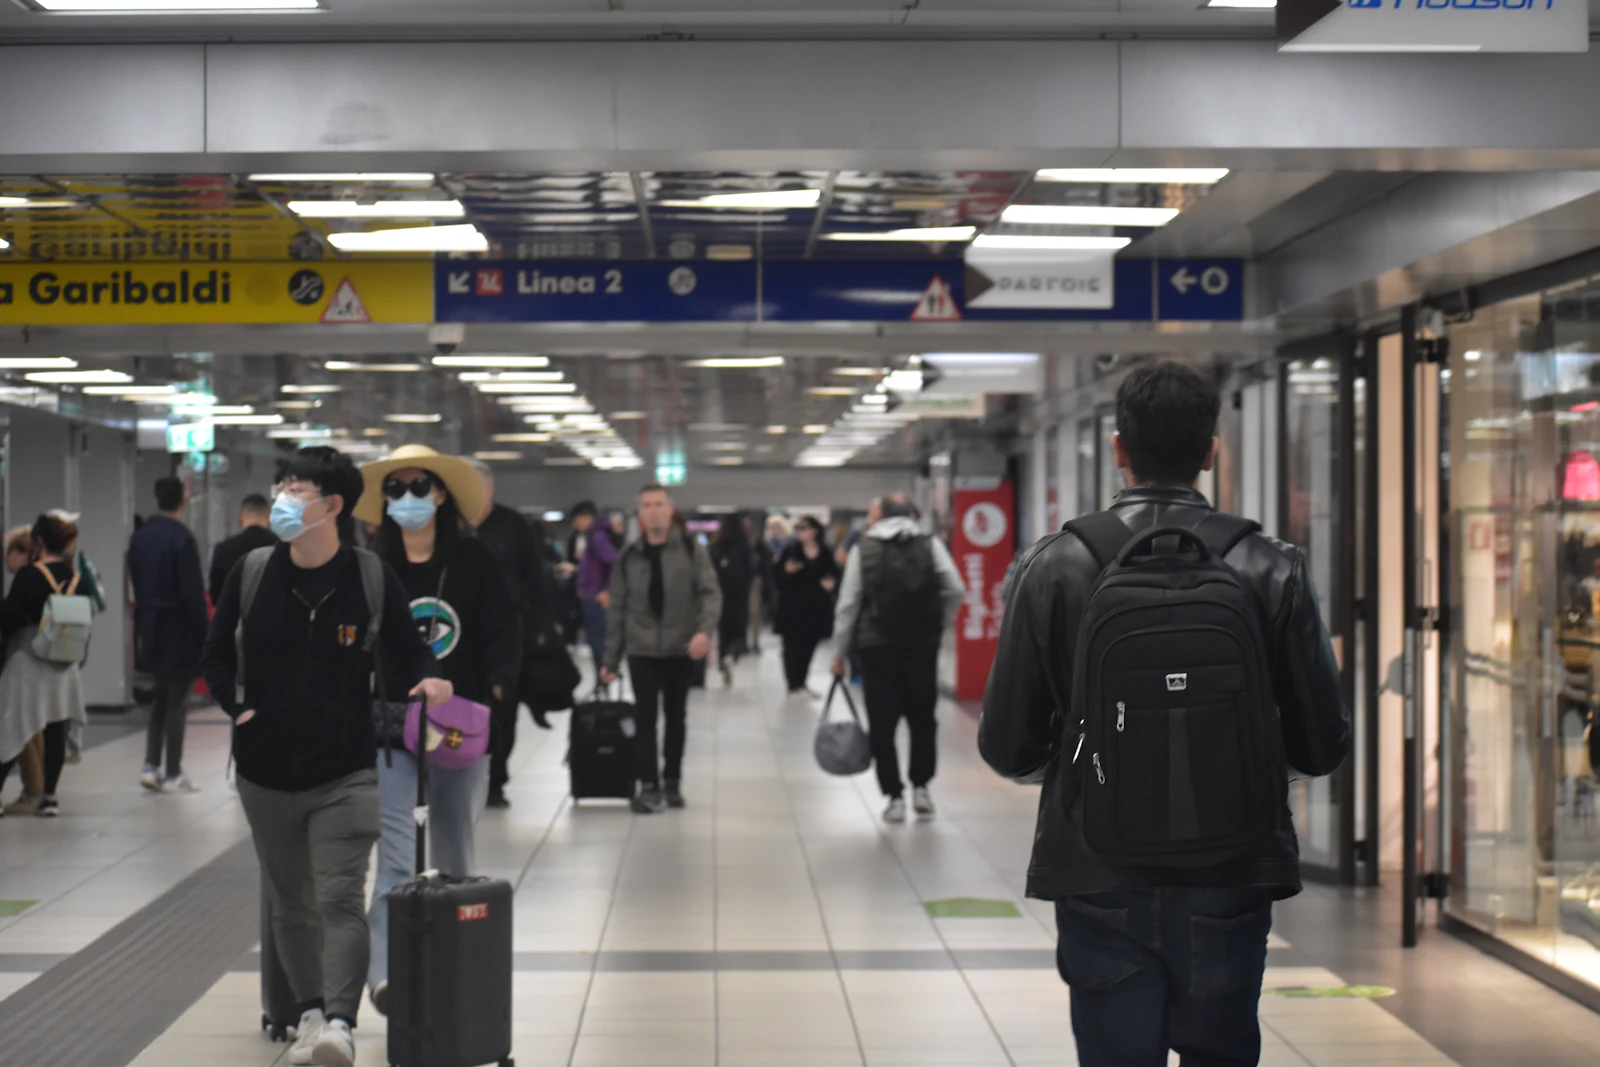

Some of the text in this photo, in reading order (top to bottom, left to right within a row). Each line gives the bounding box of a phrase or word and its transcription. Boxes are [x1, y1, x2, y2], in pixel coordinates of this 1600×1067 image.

[28, 269, 231, 305] Garibaldi
[517, 269, 596, 294] Linea
[603, 269, 623, 294] 2
